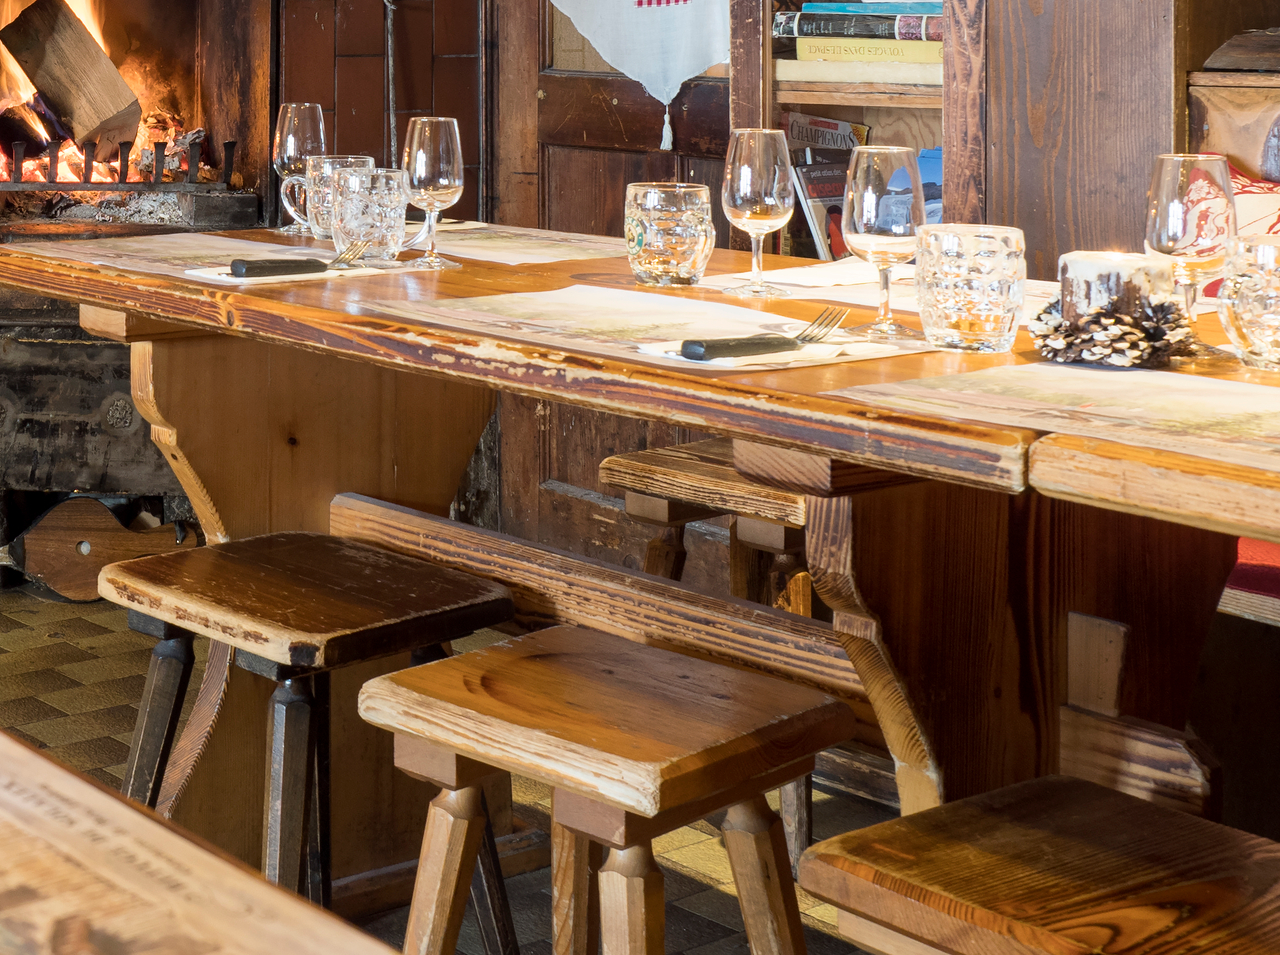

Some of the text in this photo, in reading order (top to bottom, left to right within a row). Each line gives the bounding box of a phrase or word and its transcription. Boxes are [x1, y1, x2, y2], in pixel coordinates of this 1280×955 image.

[843, 45, 866, 56] DANS
[867, 46, 905, 57] VOYAGES
[790, 120, 854, 148] CHAMPIGNONS
